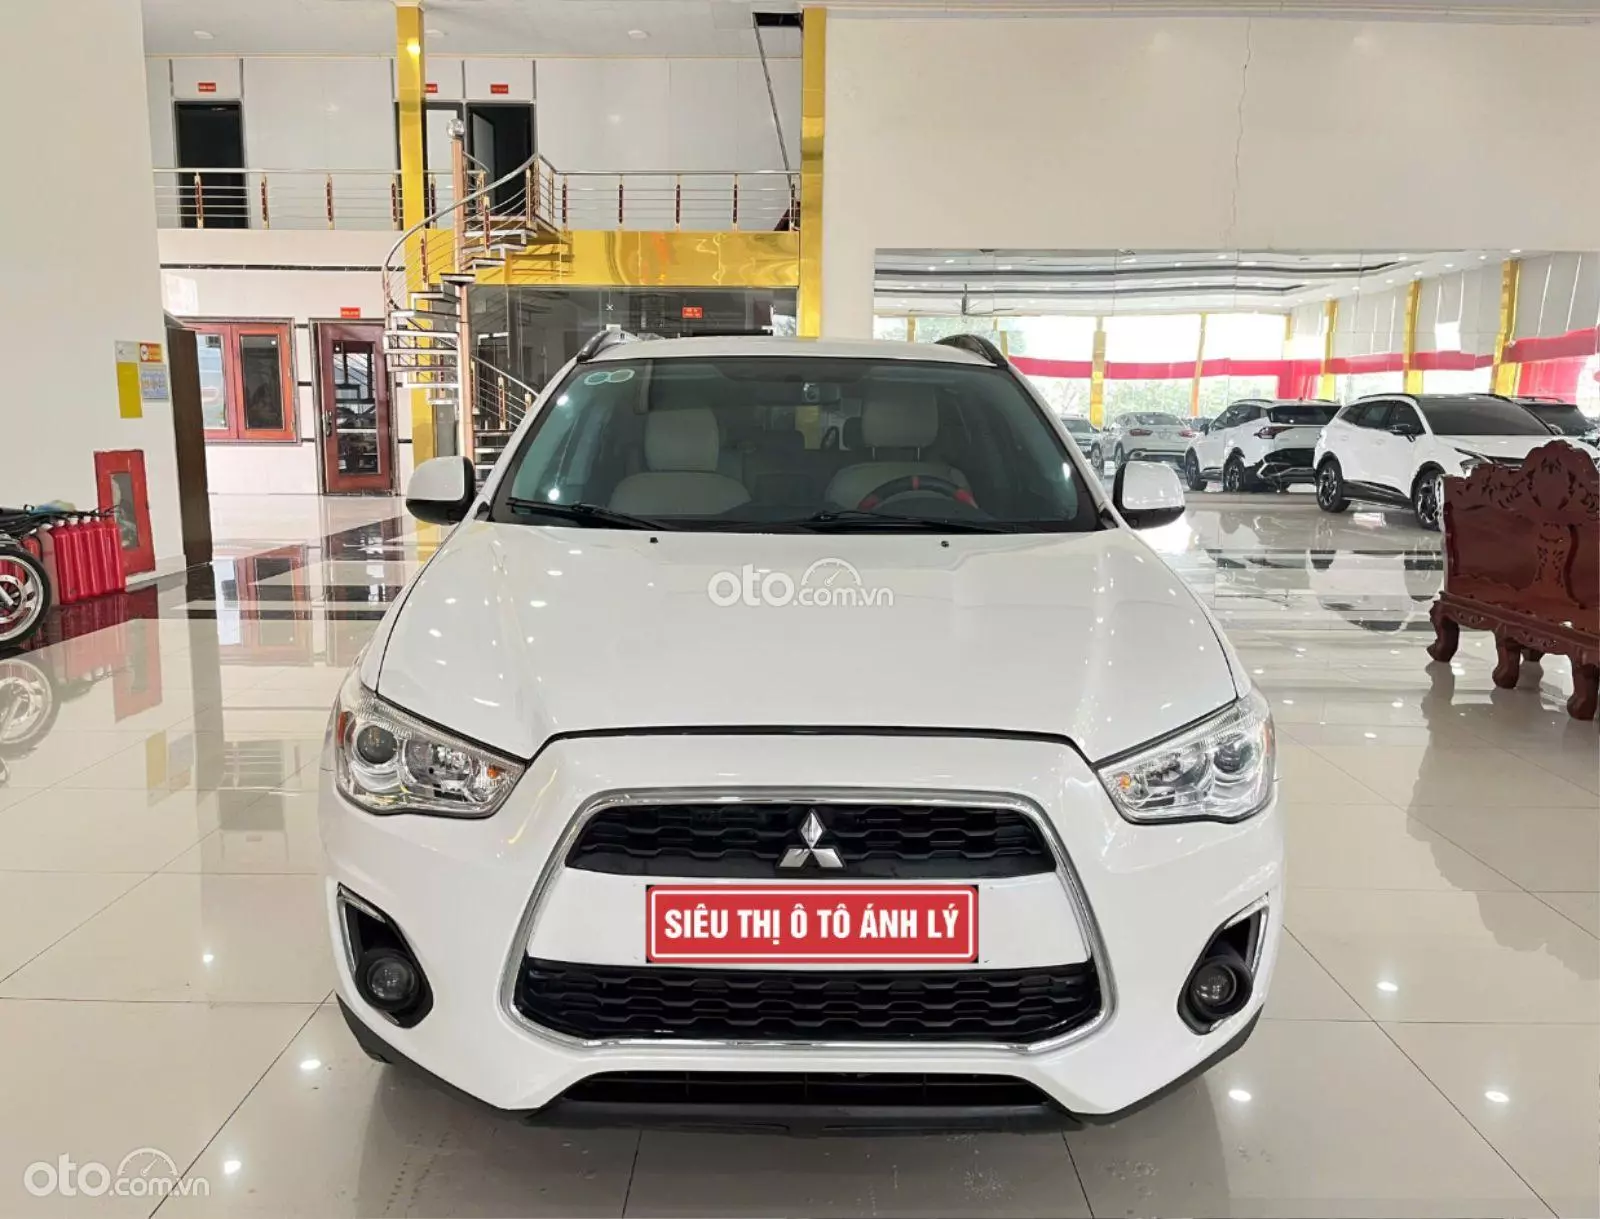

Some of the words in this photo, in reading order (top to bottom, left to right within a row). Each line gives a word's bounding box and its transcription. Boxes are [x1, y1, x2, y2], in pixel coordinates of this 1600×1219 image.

[664, 903, 729, 939] SIÊU
[737, 909, 780, 945] THỊ
[790, 903, 808, 939] Ô
[816, 903, 851, 939] TÔ
[859, 903, 918, 939] ÁNH
[927, 903, 960, 939] LÝ
